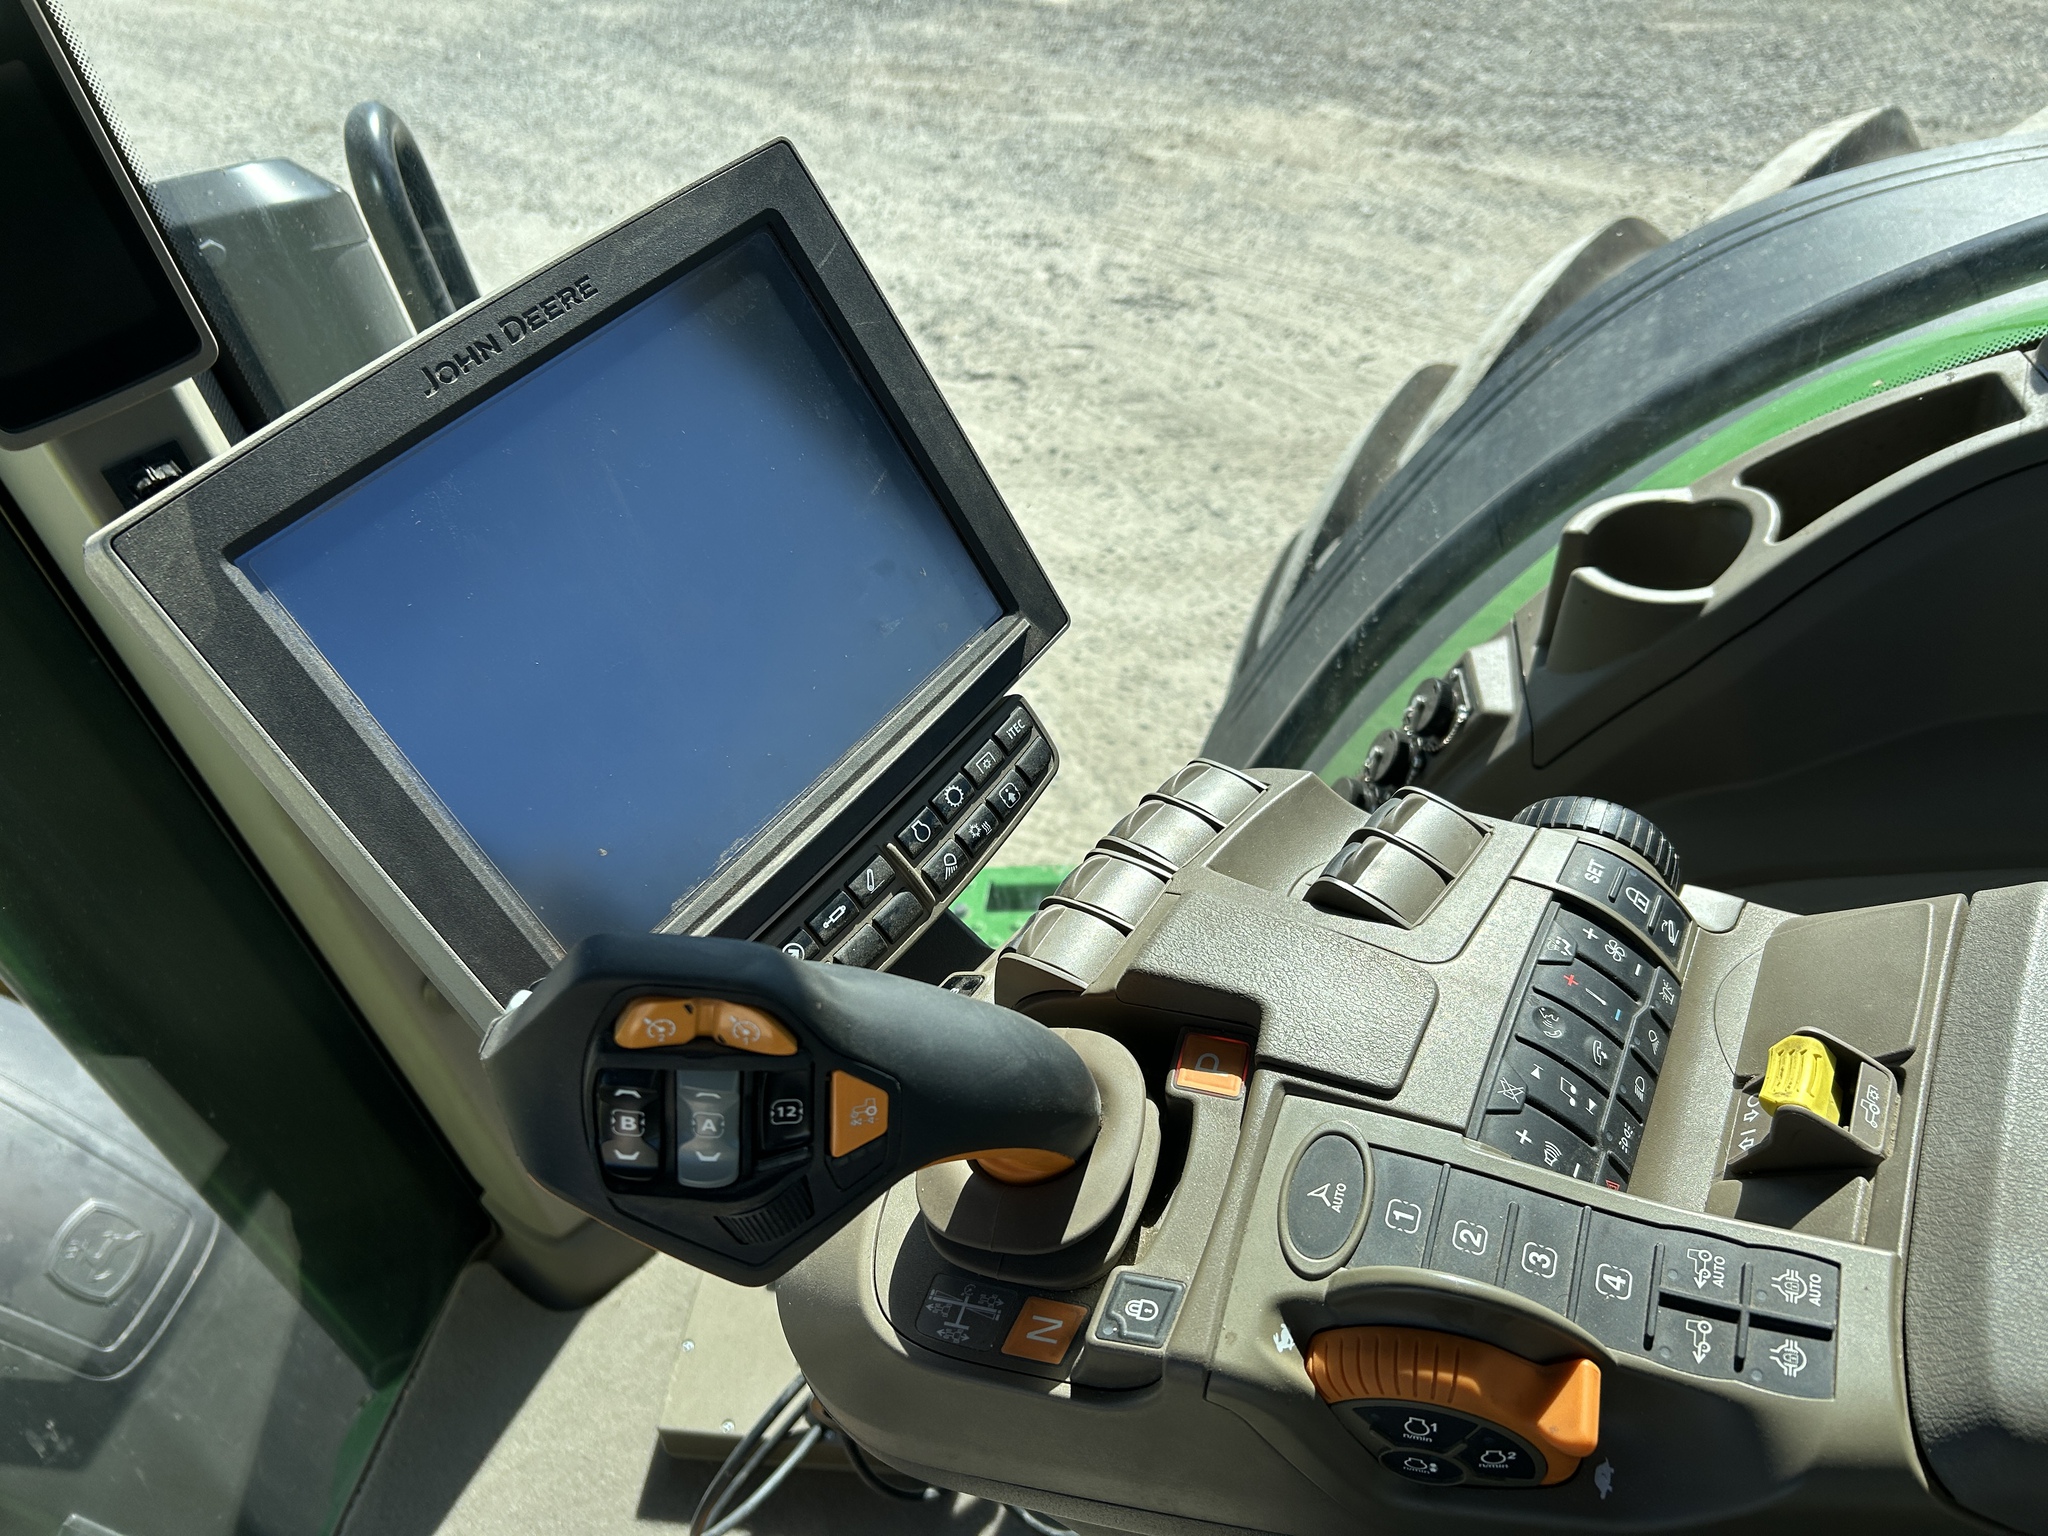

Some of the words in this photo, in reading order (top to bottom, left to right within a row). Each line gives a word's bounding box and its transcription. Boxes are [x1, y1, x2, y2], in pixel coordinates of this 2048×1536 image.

[420, 333, 503, 398] JOHN
[497, 274, 599, 346] DEERE
[1006, 721, 1026, 740] iTEC
[1584, 859, 1606, 884] SET
[1195, 1052, 1229, 1078] P
[776, 1106, 797, 1118] 12
[621, 1116, 636, 1129] B
[701, 1118, 717, 1132] A
[1331, 1183, 1347, 1213] AUTO
[1392, 1210, 1415, 1222] 1
[1459, 1229, 1482, 1248] 2
[1528, 1251, 1551, 1269] 3
[1713, 1255, 1726, 1288] AUTO
[1603, 1273, 1627, 1291] 4
[1809, 1273, 1822, 1307] AUTO
[1026, 1315, 1064, 1345] N
[1431, 1423, 1438, 1432] 1
[1402, 1433, 1433, 1443] n/min
[1507, 1451, 1517, 1460] 2
